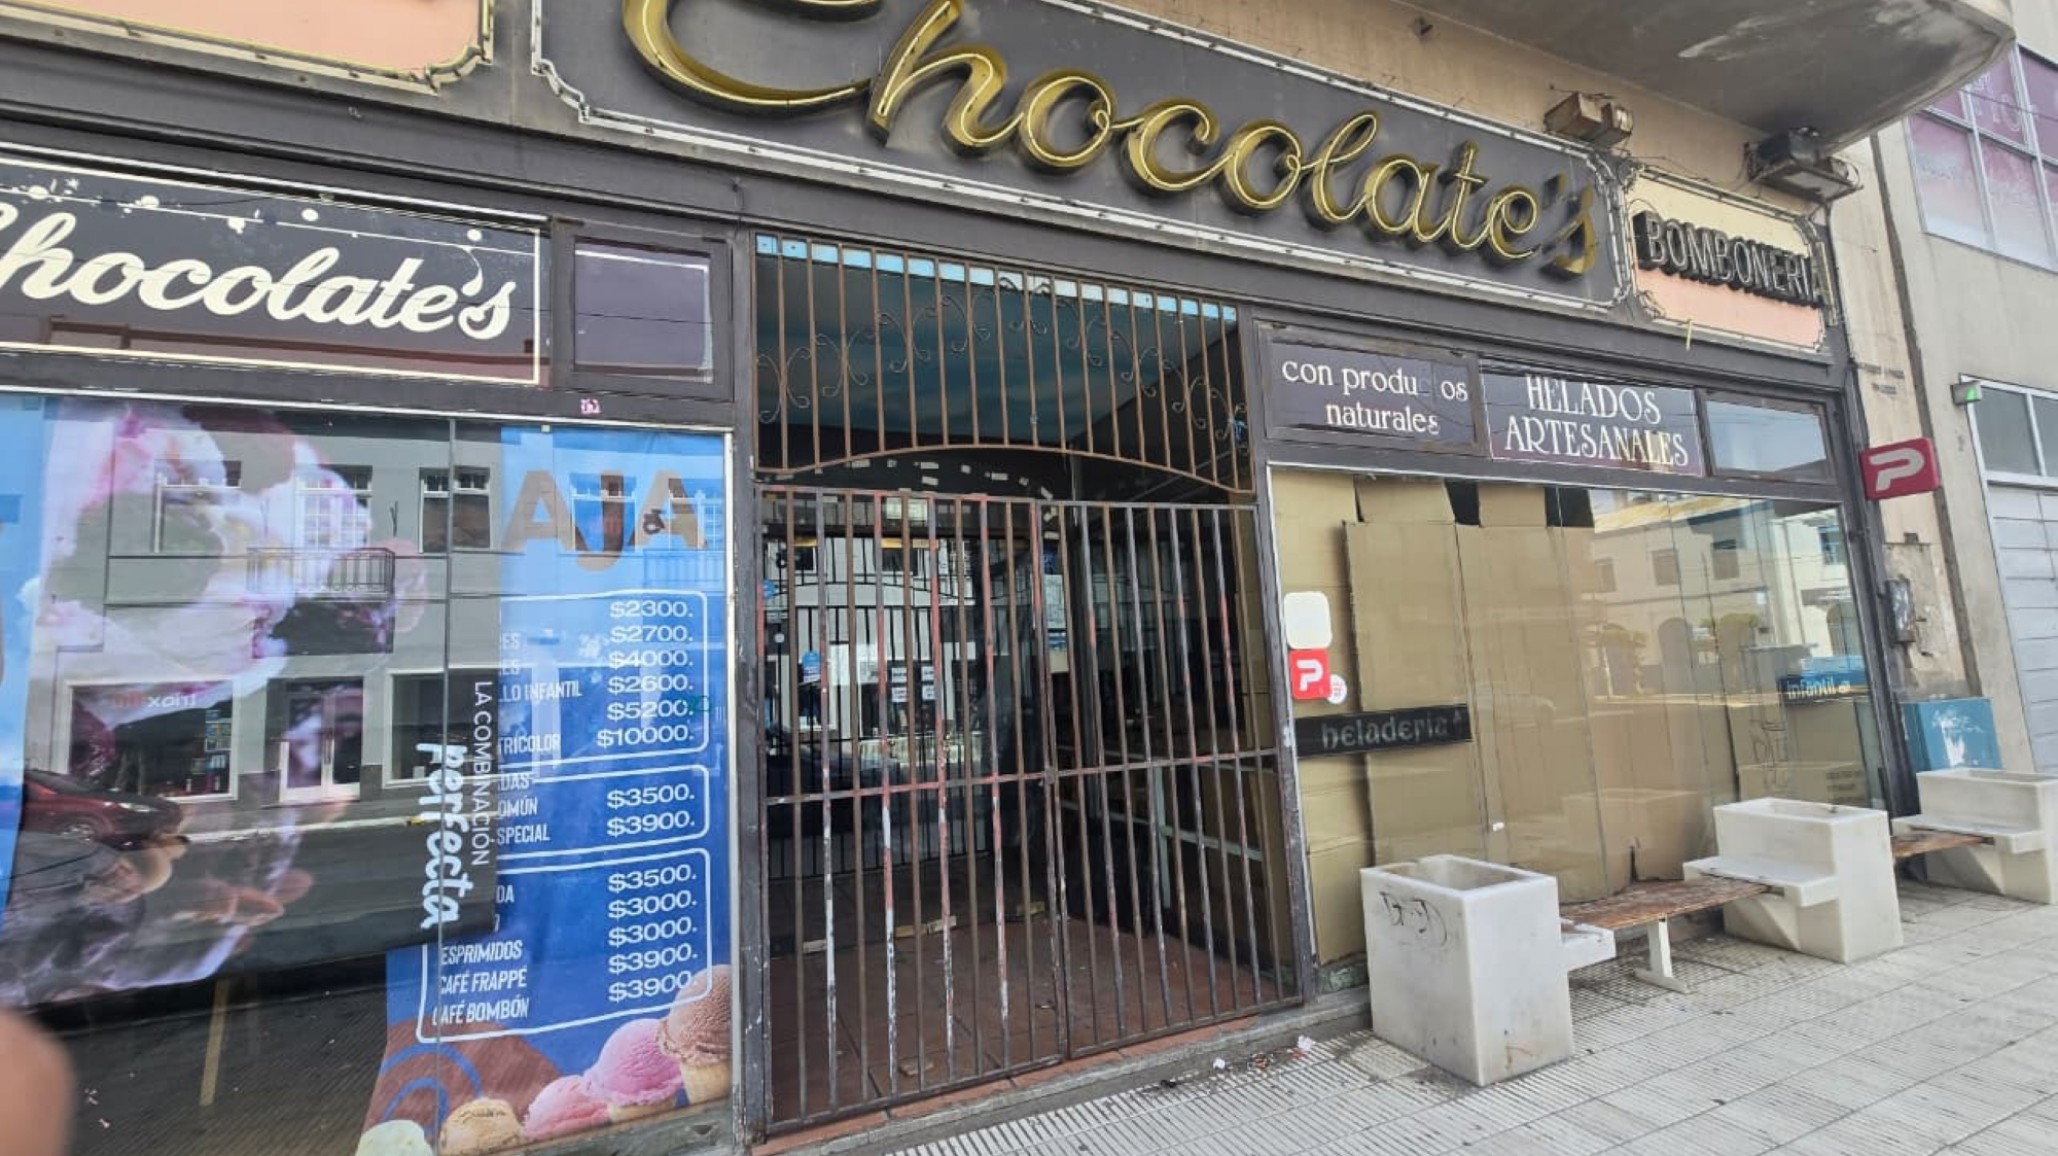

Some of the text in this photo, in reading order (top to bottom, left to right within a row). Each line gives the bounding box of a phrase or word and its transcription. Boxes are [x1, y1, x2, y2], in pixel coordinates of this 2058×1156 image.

[0, 202, 512, 340] hocolate's
[1282, 360, 1469, 402] con produos
[1526, 374, 1662, 425] HELADOS
[1325, 402, 1440, 435] naturales
[1504, 415, 1690, 467] ARTESANALES
[609, 600, 694, 618] $2300.
[610, 624, 694, 643] $2700.
[609, 650, 694, 669] $4000.
[524, 679, 582, 700] INFANTIL
[607, 673, 694, 696] $2600.
[607, 699, 694, 722] $5200.
[597, 724, 695, 748] $10000.
[471, 682, 496, 866] LA COMBINACIÓN
[606, 783, 695, 809] $3500.
[416, 743, 474, 929] perfecta
[606, 810, 695, 837] $3900.
[608, 864, 697, 893] $3500.
[608, 890, 697, 920] $3000.
[608, 916, 698, 948] $3000.
[608, 943, 698, 974] $3900.
[471, 965, 528, 993] FRAPPÉ
[465, 994, 530, 1023] BOMBÓN
